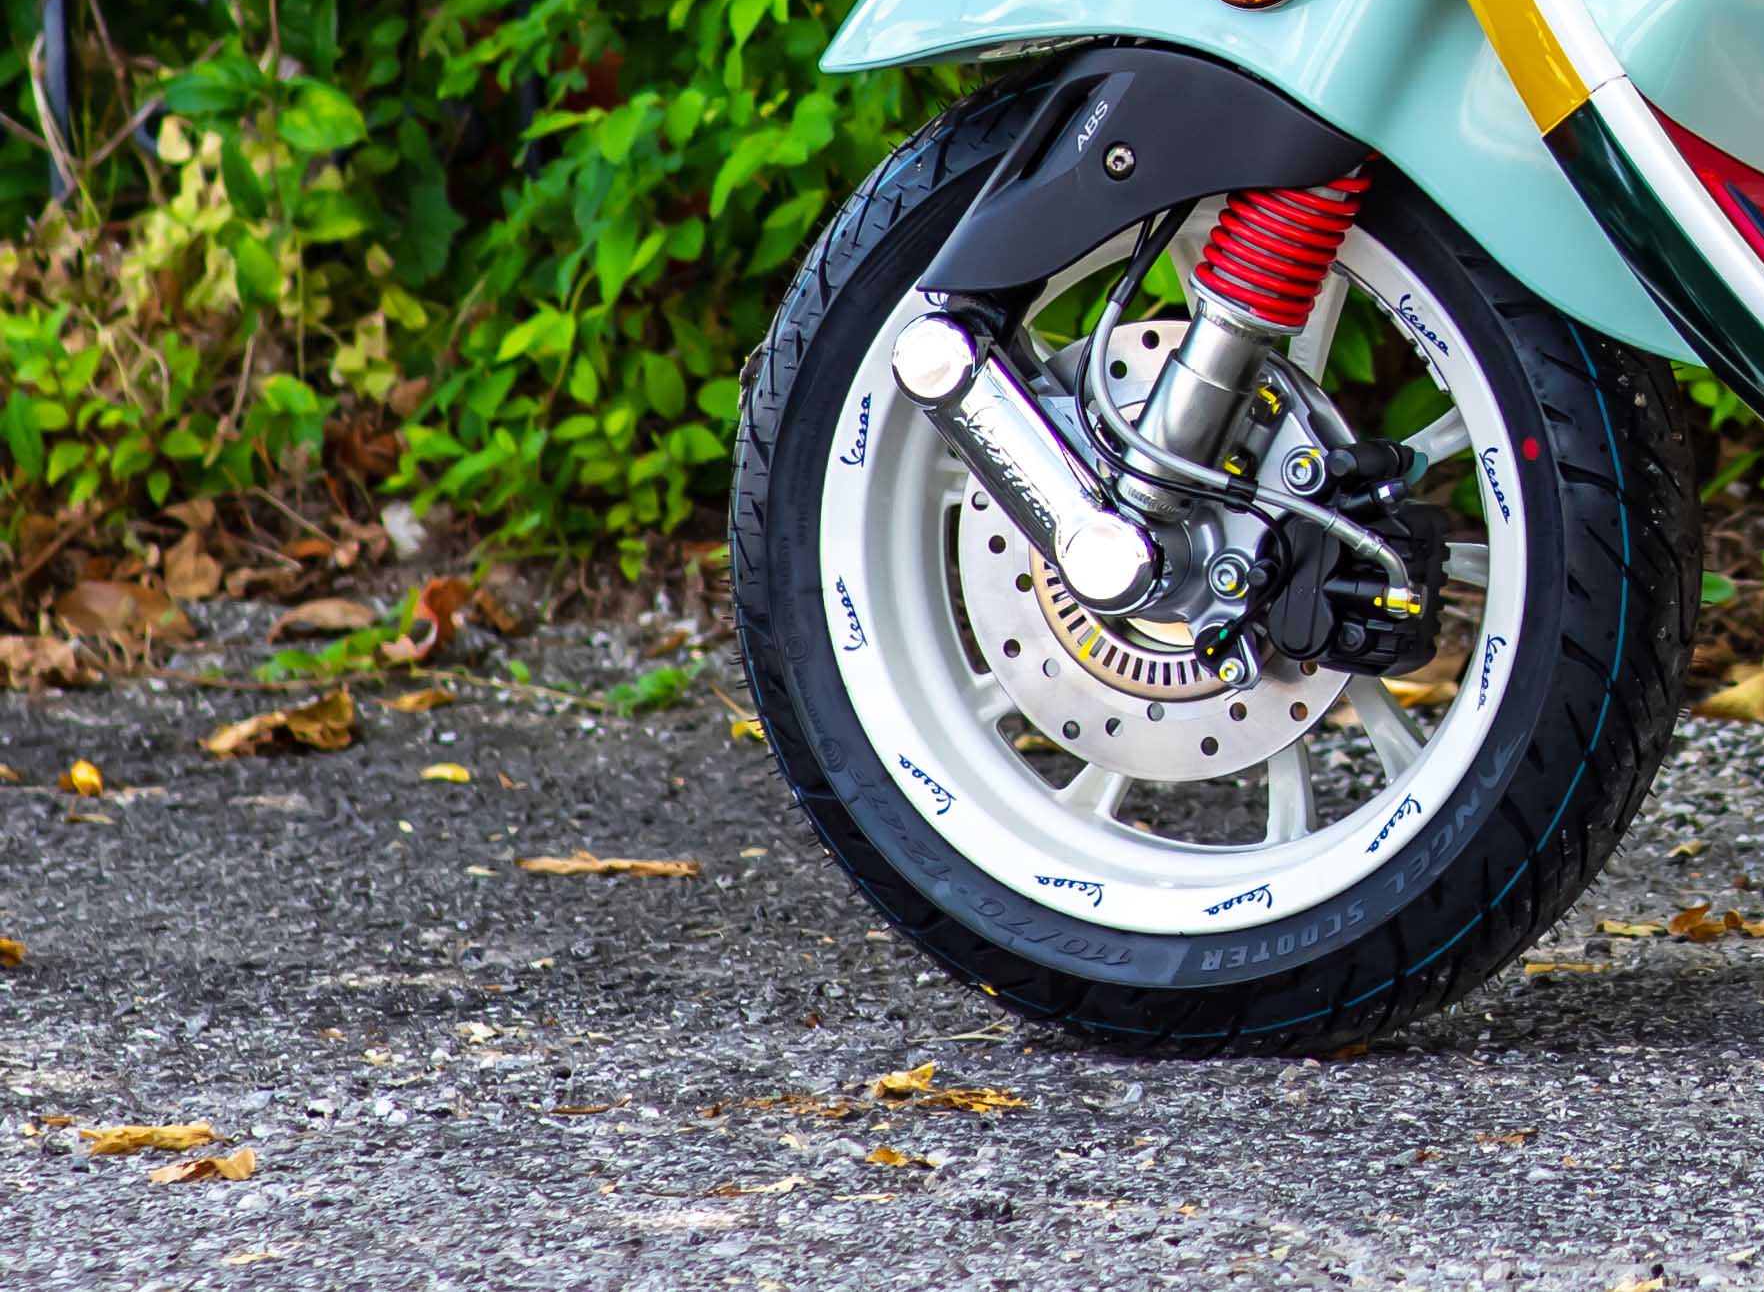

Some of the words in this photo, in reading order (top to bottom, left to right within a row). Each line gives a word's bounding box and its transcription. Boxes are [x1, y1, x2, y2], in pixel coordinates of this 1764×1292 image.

[1077, 101, 1108, 153] ABS
[1397, 293, 1450, 357] Vespa
[839, 392, 872, 468] Vespa
[1480, 447, 1510, 524] Vespa
[836, 574, 869, 652] Vespa
[1477, 634, 1507, 712] Vespa
[898, 754, 957, 815] Vespa
[1366, 794, 1422, 854] Vespa
[1034, 875, 1105, 907] Vespa
[1203, 884, 1272, 916] Vespa
[1201, 898, 1366, 971] SCOOTER
